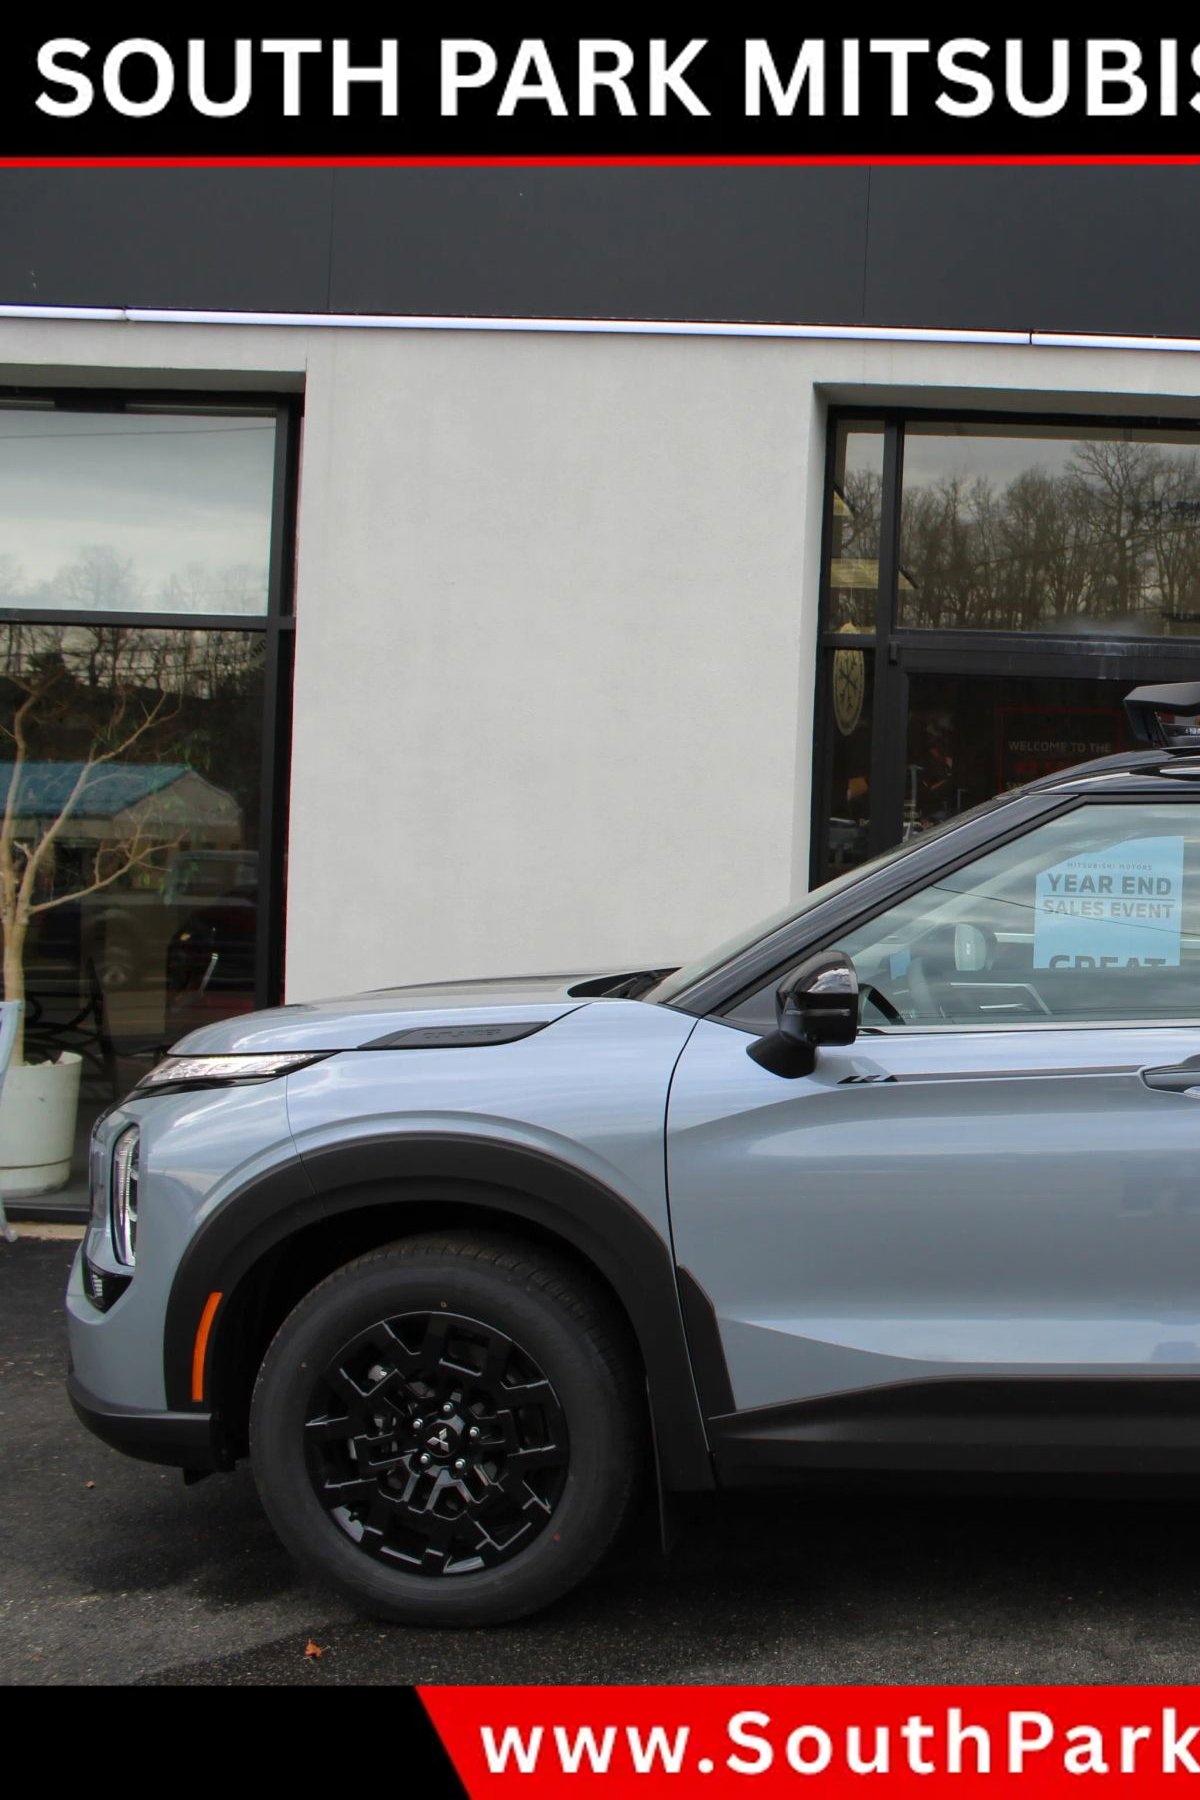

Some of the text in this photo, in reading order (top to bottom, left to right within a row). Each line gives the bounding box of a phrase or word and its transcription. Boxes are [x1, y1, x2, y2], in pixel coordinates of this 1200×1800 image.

[1008, 741, 1112, 754] WELCOME TO THE
[1067, 862, 1152, 871] MITSUBISHI MOTORS
[1047, 873, 1172, 896] YEAR END
[1043, 899, 1174, 919] SALES EVENT
